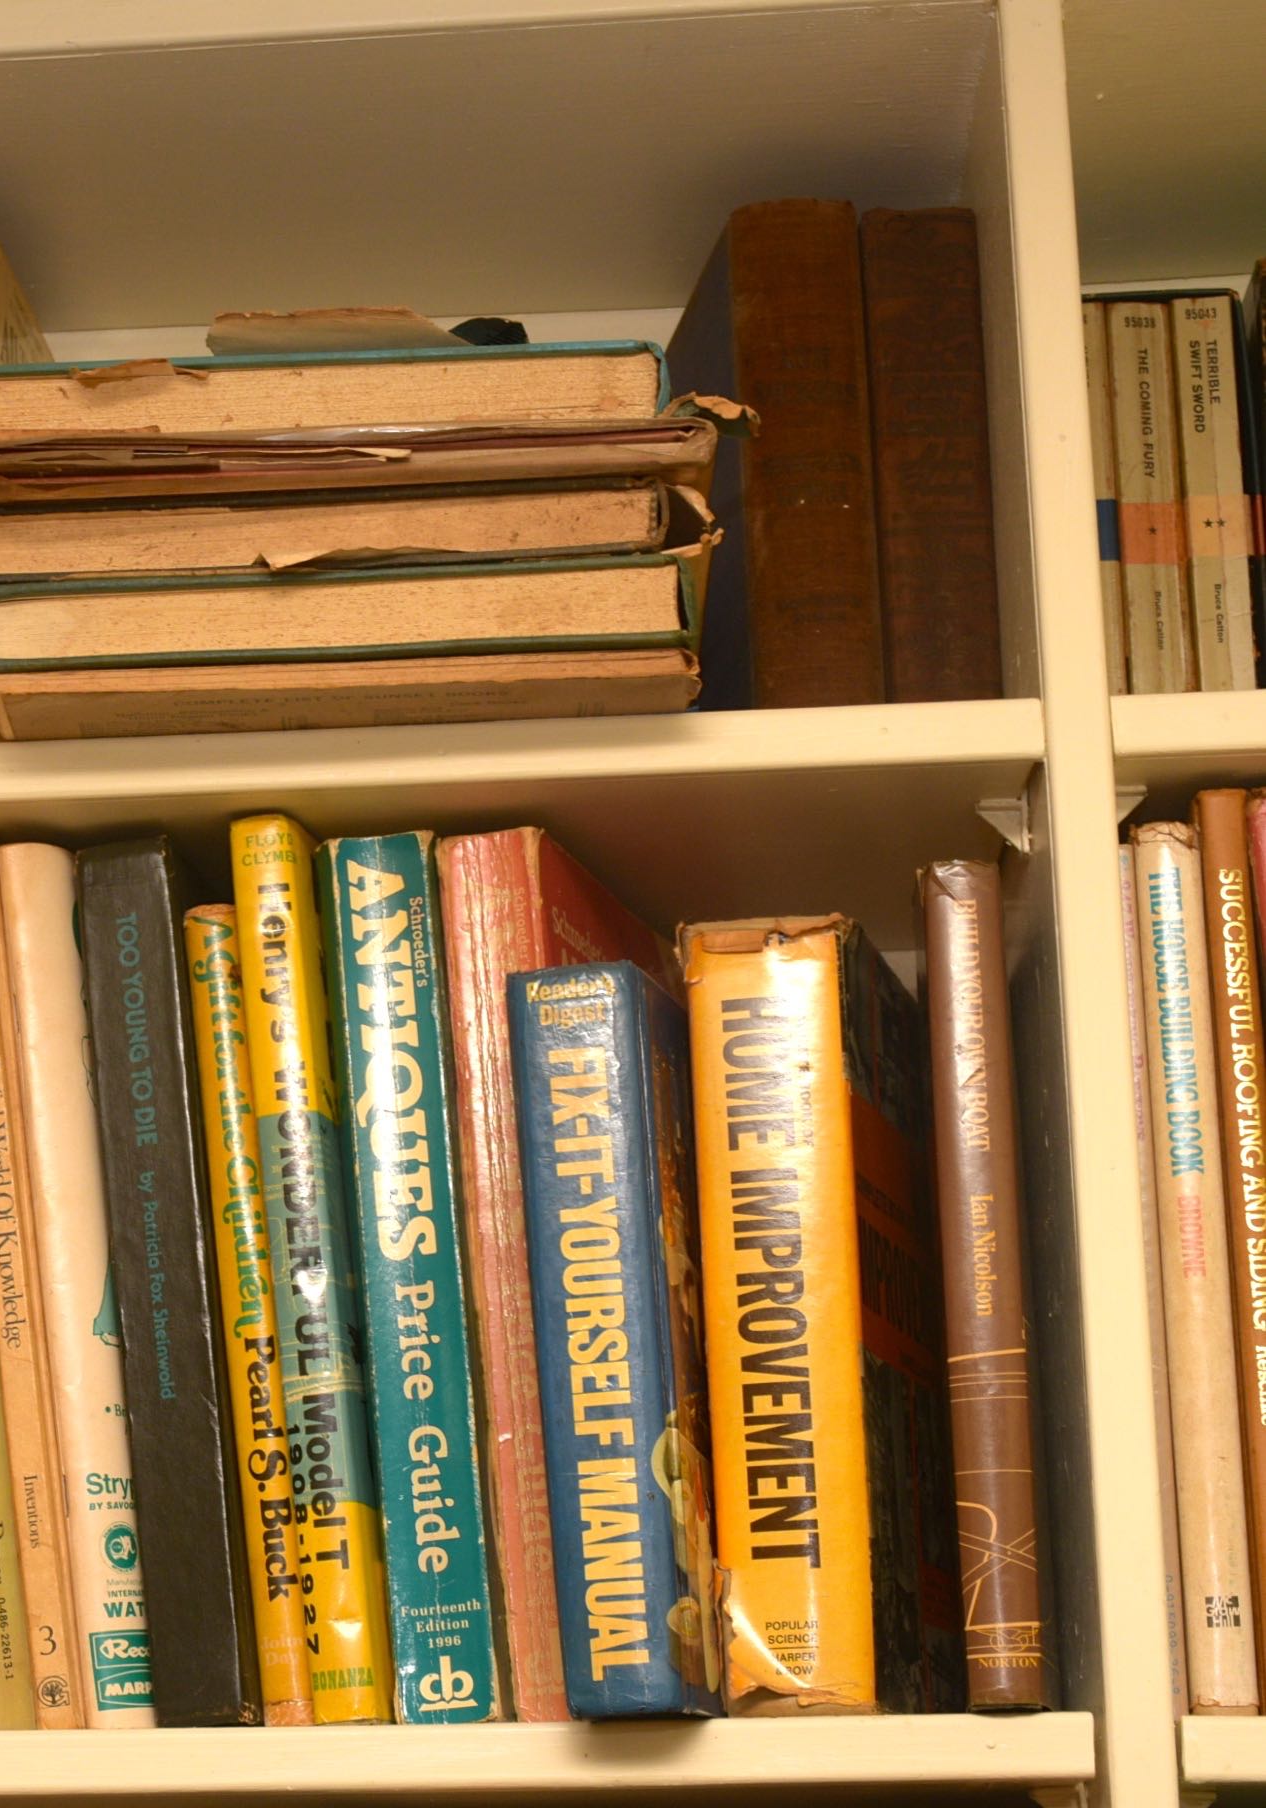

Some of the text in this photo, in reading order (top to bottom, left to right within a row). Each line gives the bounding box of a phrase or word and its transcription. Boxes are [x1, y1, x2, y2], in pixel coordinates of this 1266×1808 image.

[1137, 348, 1156, 479] THE COMING FURY
[1189, 340, 1206, 434] SWIFT SWORD
[1205, 340, 1221, 405] TERRIBLE
[408, 895, 428, 988] Schroeder's
[116, 912, 158, 1147] TOO YOUNG DIE
[539, 1002, 607, 1028] Digest
[1151, 916, 1206, 1177] HOUSE BUILDING BOOK
[1219, 868, 1265, 1168] SUCCESSFUL ROOFING
[223, 1154, 270, 1338] Children
[257, 881, 347, 1529] Henry's Model
[345, 857, 461, 1575] ANTIQUES Price Guide
[547, 1045, 635, 1448] FIX-IT-YOURSELF
[970, 1193, 996, 1317] Ian Nicolson
[142, 1199, 176, 1401] Patricia Sheinwold
[721, 996, 822, 1568] HOME IMPROVEMENT
[23, 1474, 40, 1550] Inventions
[244, 1336, 299, 1602] Pearl Buck
[400, 1598, 483, 1618] Fourteenth
[415, 1617, 470, 1634] Edition
[576, 1458, 651, 1683] MANUAL
[311, 1667, 374, 1692] BONANZA
[427, 1635, 462, 1649] 1996
[979, 1656, 1039, 1669] NORTON
